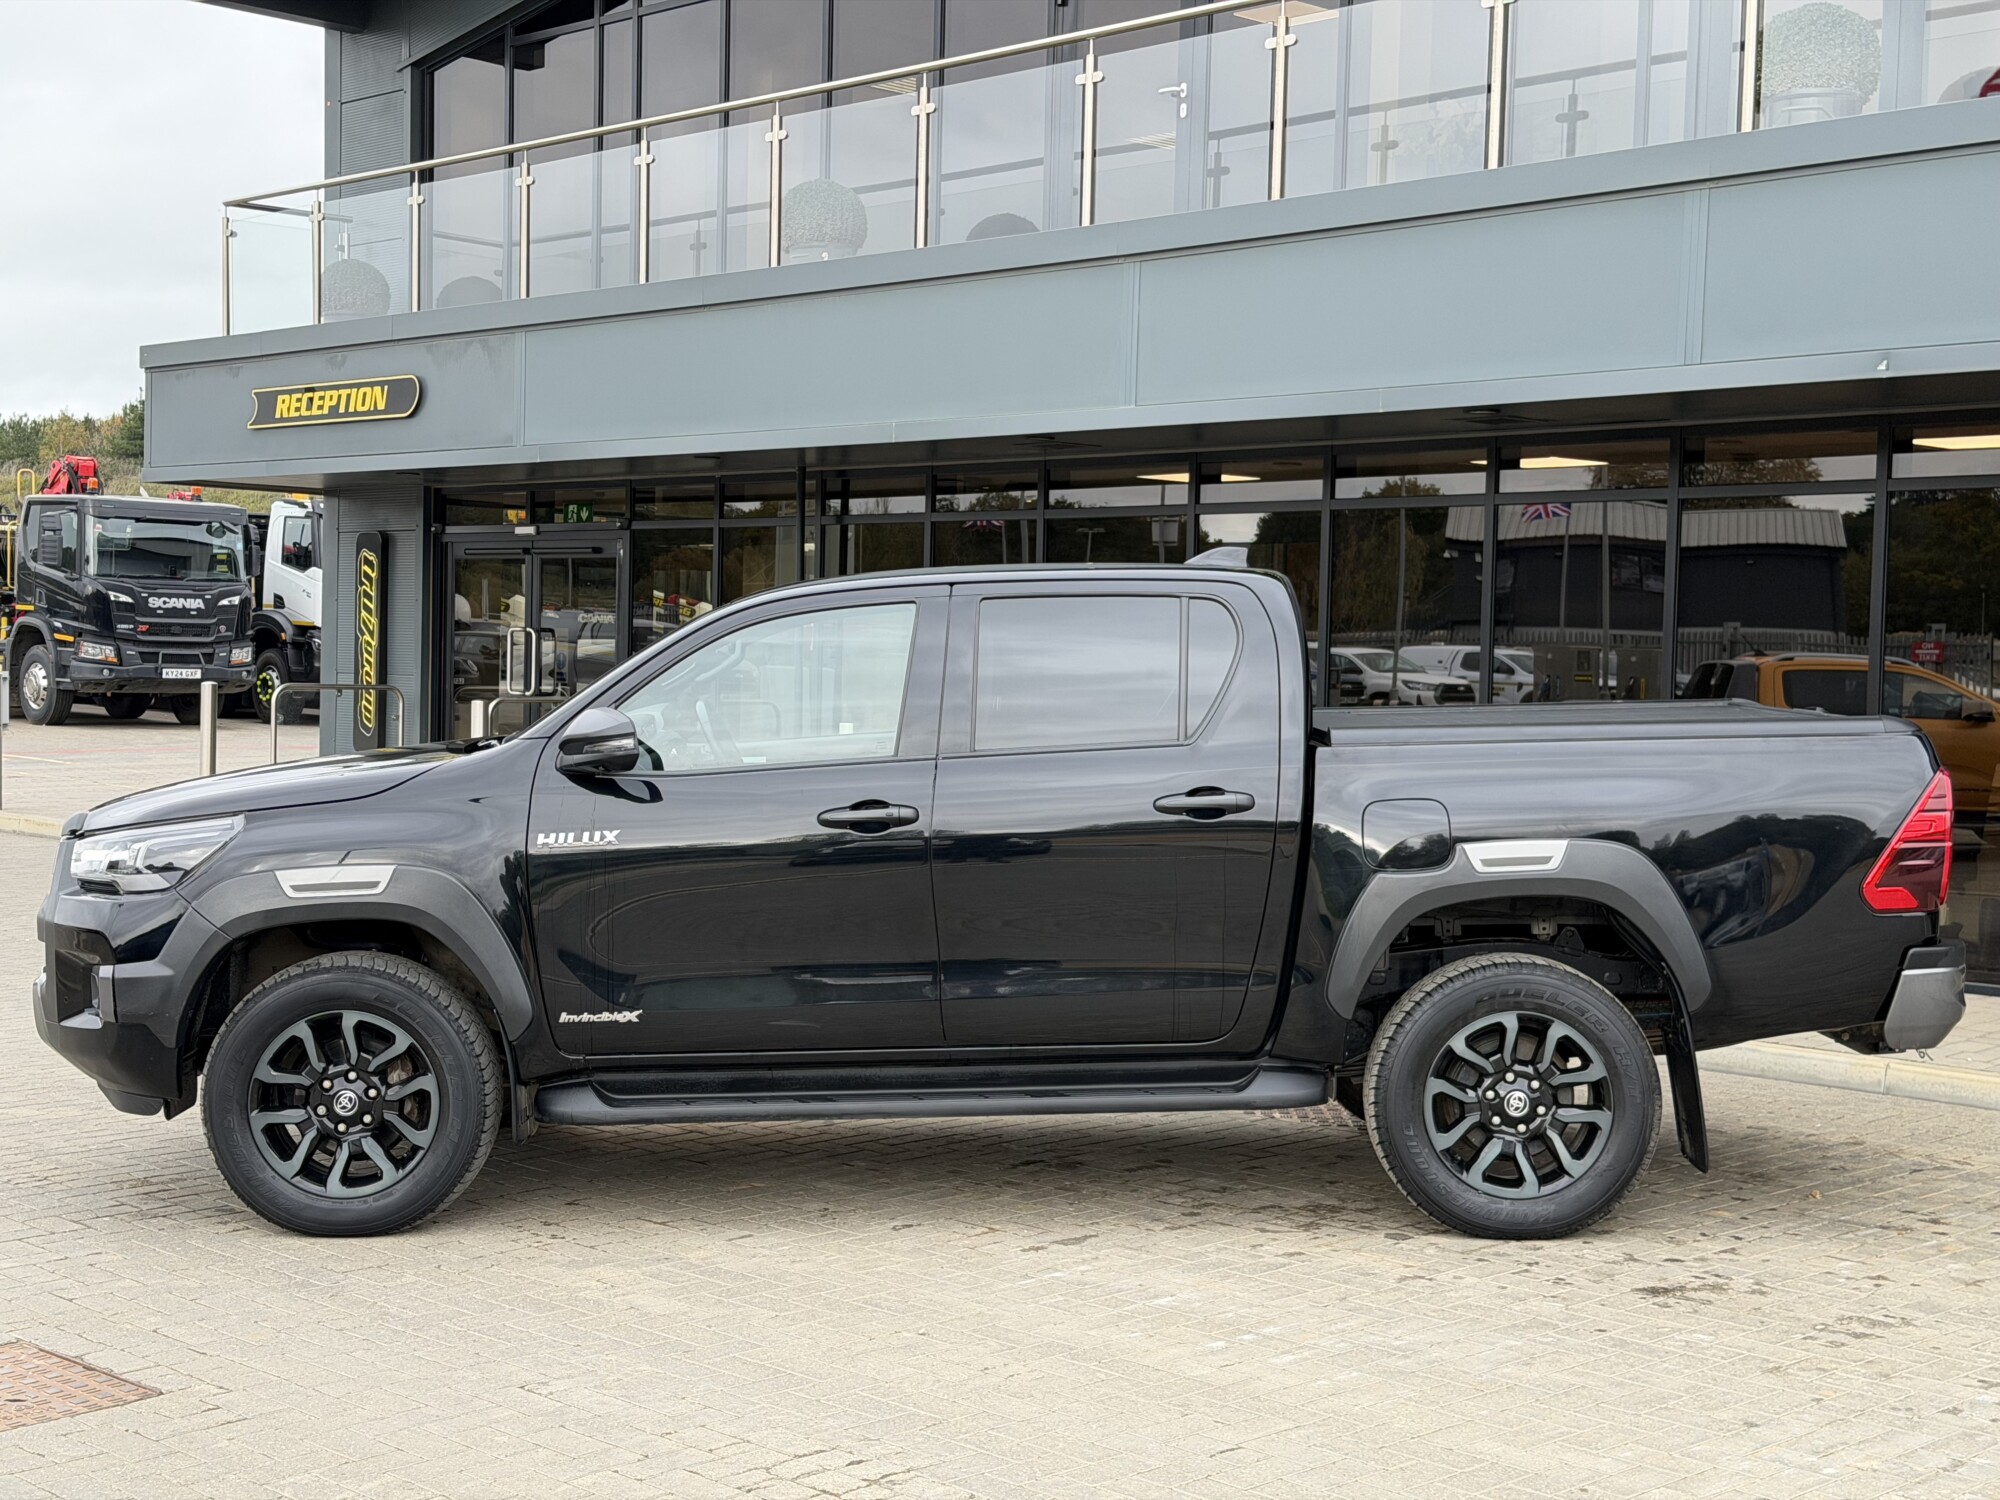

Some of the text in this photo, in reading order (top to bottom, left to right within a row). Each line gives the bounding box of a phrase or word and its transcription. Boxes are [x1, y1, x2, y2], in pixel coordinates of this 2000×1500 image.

[275, 385, 388, 419] RECEPTION
[148, 597, 205, 609] SCANIA
[537, 829, 621, 847] HILUX
[1474, 986, 1609, 1033] DUELER
